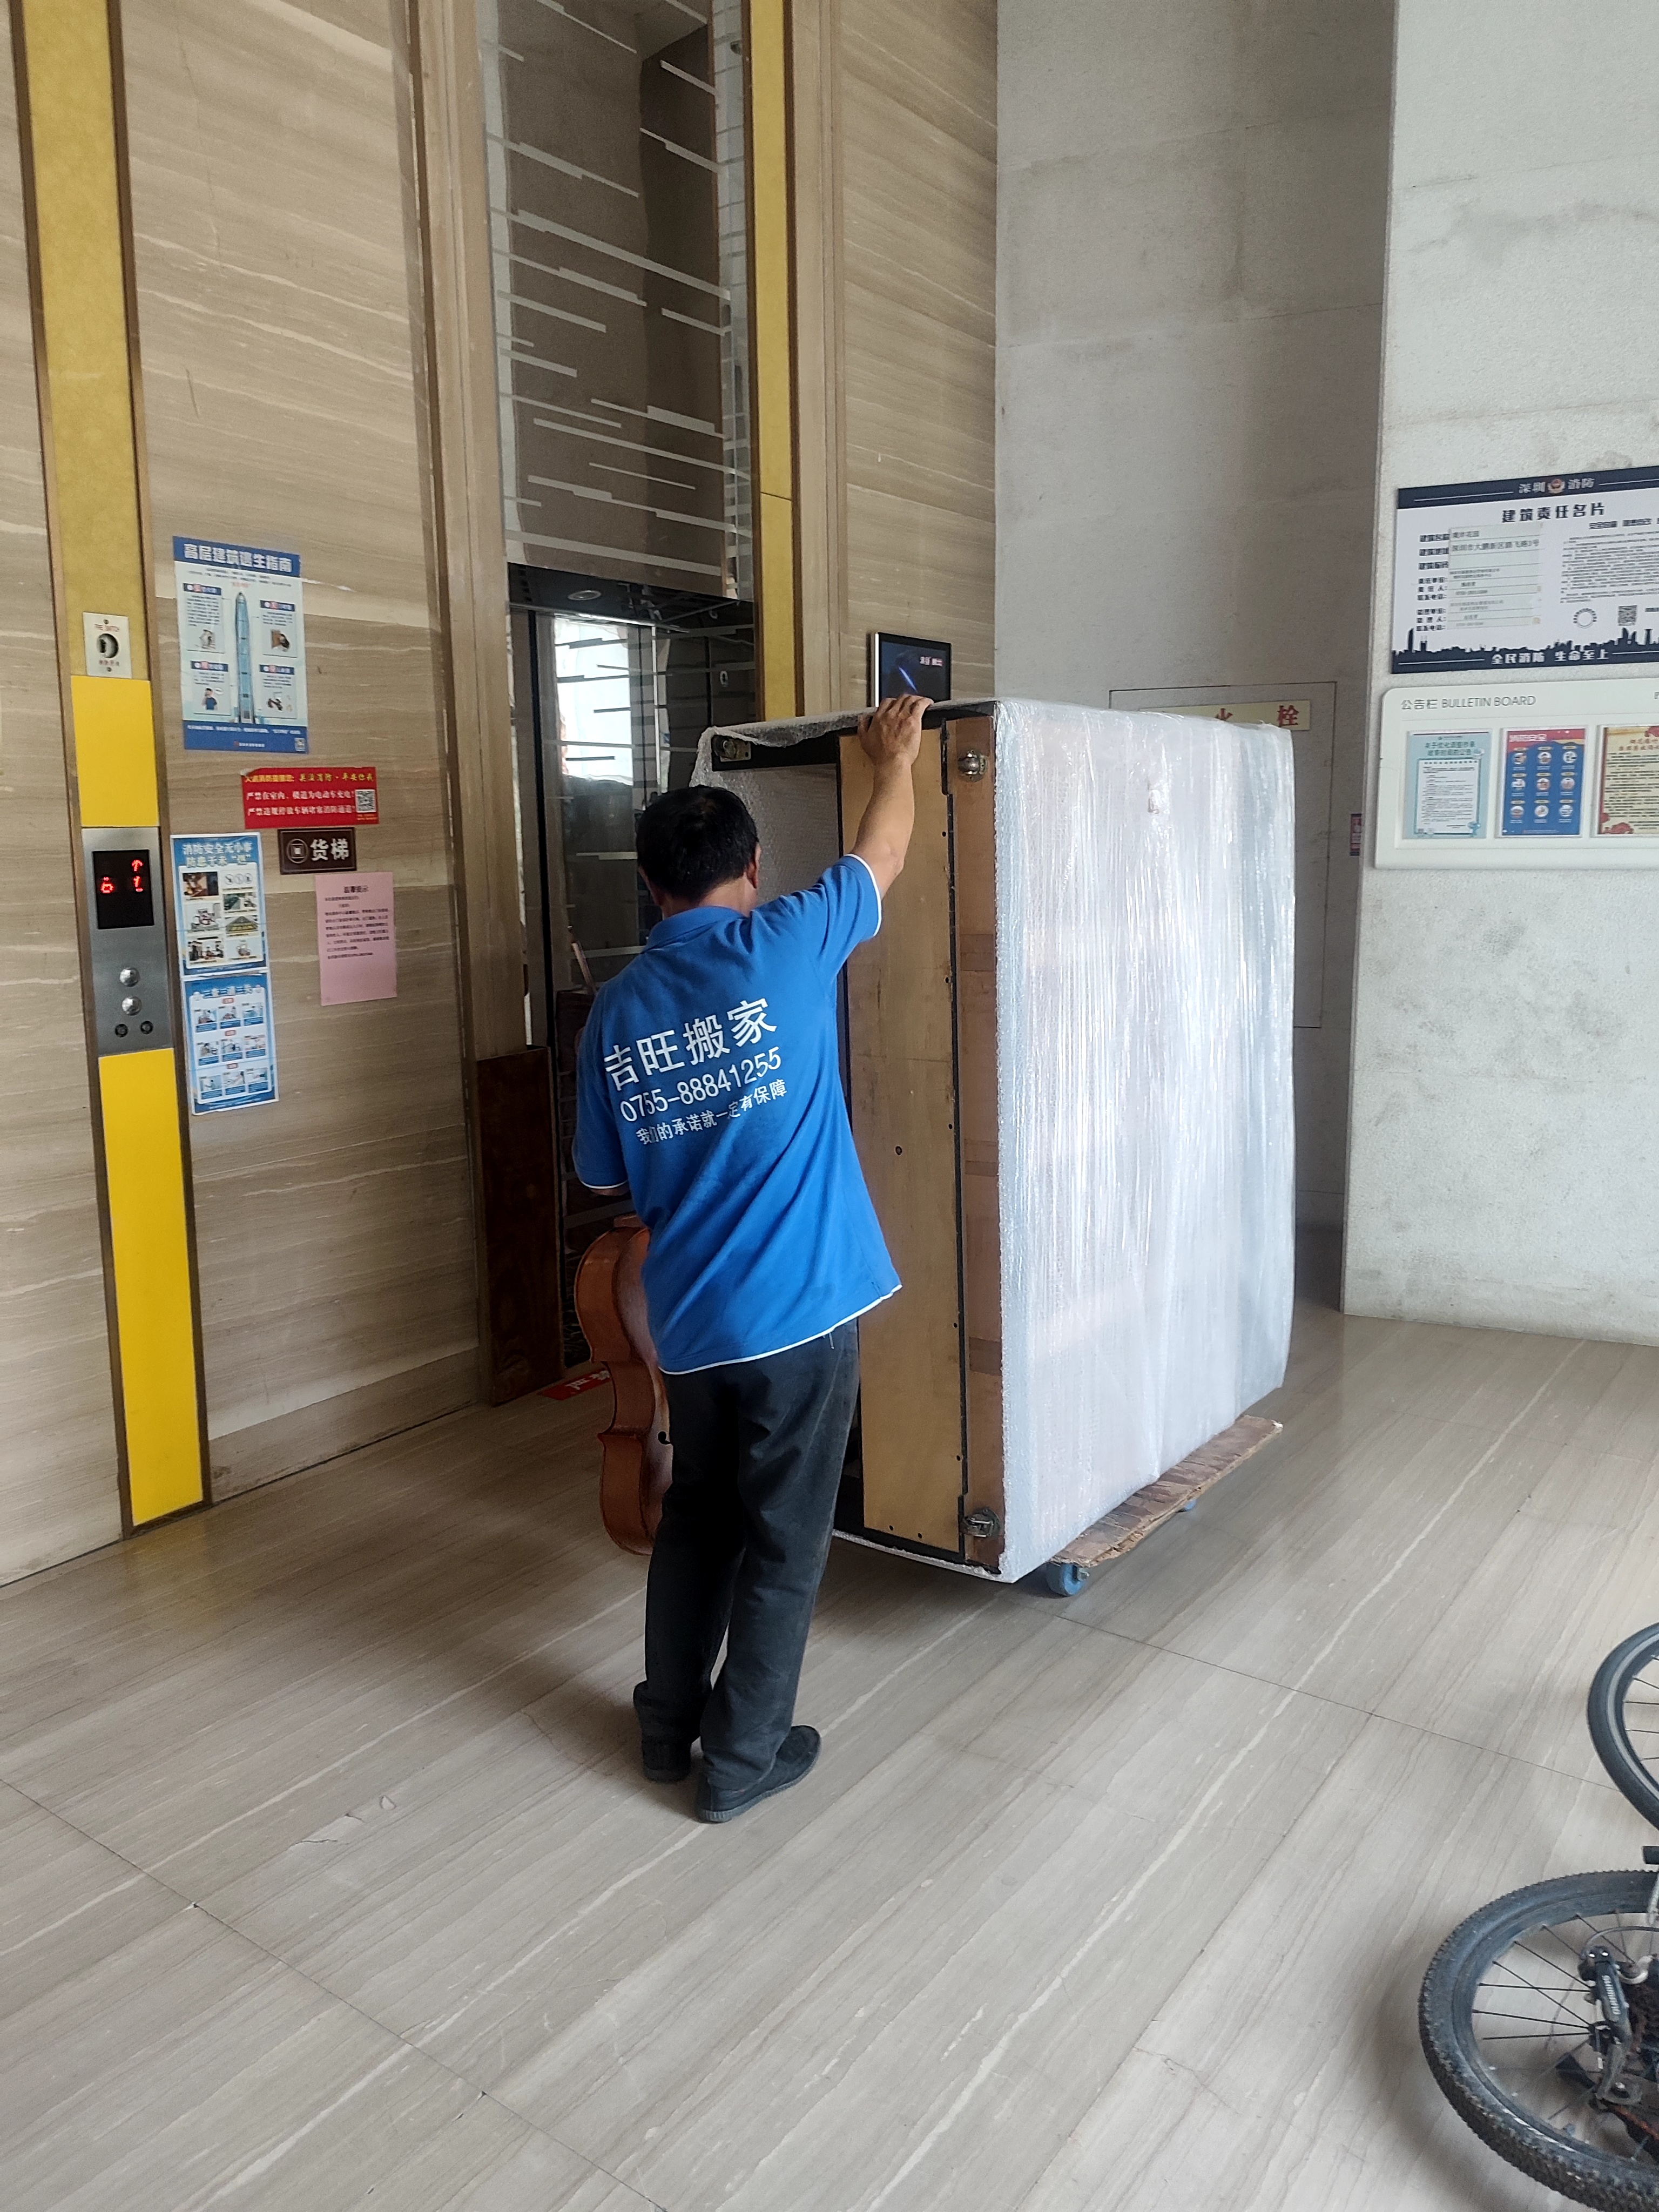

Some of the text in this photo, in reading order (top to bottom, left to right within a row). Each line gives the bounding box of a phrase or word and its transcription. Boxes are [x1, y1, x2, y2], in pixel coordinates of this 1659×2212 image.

[1519, 482, 1546, 494] 深圳
[1501, 502, 1605, 523] 建筑责任名片
[1491, 649, 1609, 664] 全民消防 生命至上
[1401, 696, 1536, 710] 公告栏 BULLETIN BOARD
[310, 838, 350, 861] 货梯
[604, 998, 777, 1091] 吉旺搬家
[621, 1047, 781, 1122] 0755-88841255
